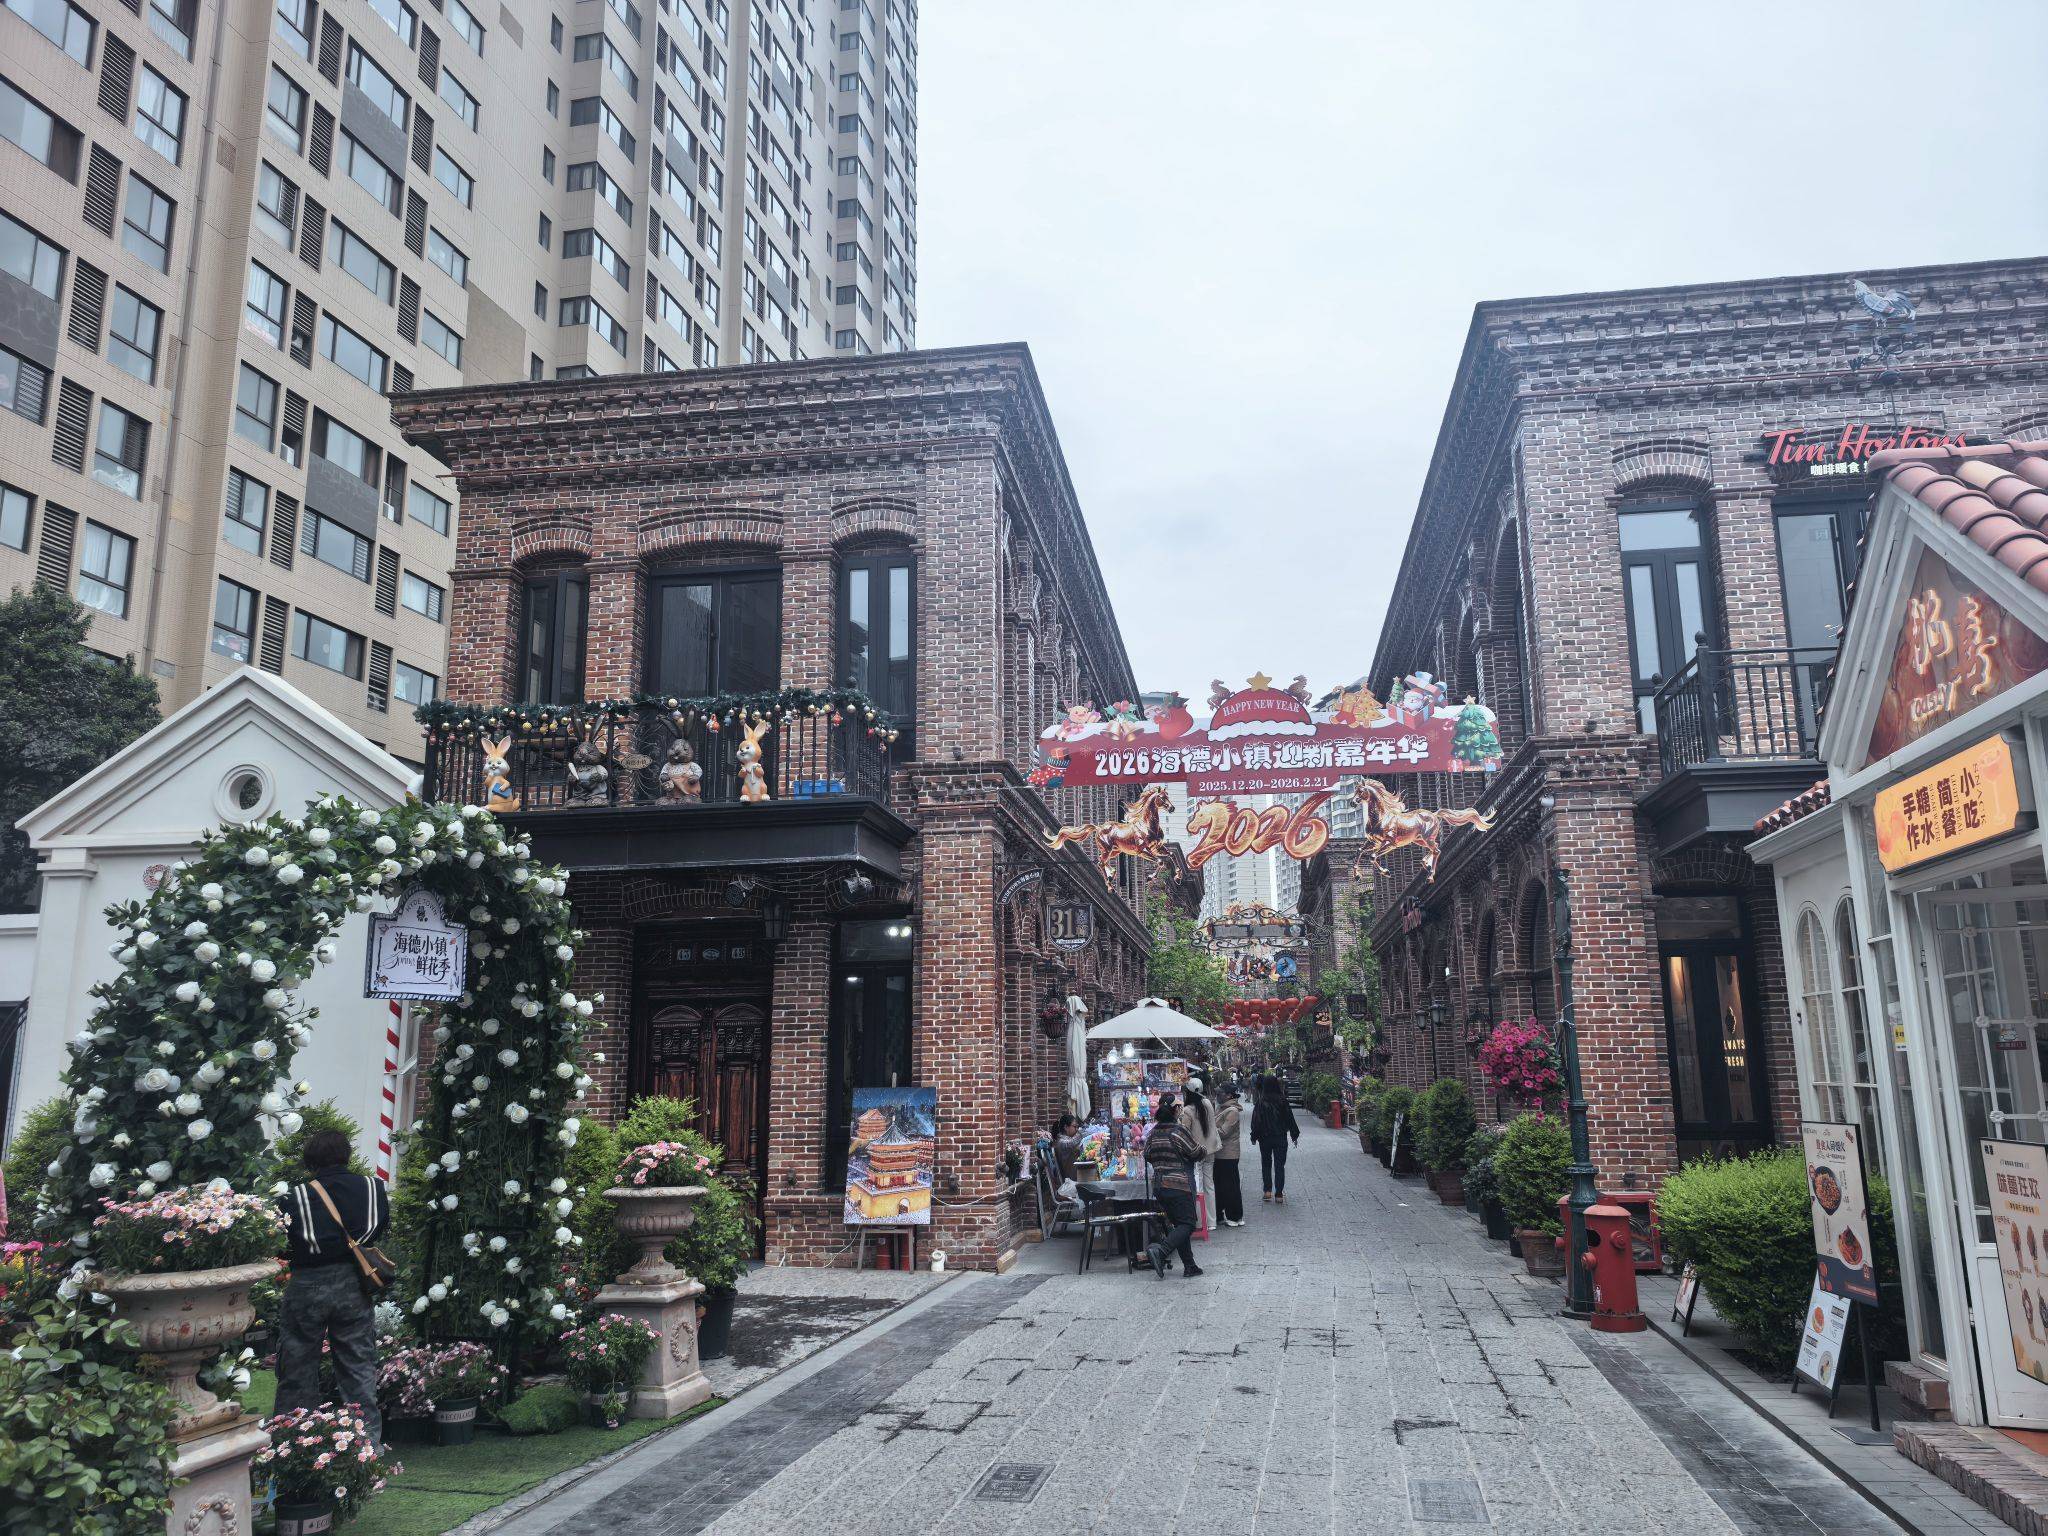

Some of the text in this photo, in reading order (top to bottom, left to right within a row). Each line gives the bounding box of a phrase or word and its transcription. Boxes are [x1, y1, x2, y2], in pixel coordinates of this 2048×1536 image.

[1764, 423, 1968, 465] Tim Hortons
[1810, 461, 1860, 476] 咖啡暖食
[1222, 699, 1300, 717] HAPPY NEW YEAR
[1095, 735, 1430, 777] 2026海德小镇迎新嘉年华
[1936, 777, 1957, 839] 简餐
[1960, 767, 1981, 829] 小吃
[1186, 791, 1335, 870] 2026
[393, 931, 448, 957] 海德小镇
[415, 954, 451, 981] 鲜花季
[1723, 1038, 1746, 1050] LWAYS
